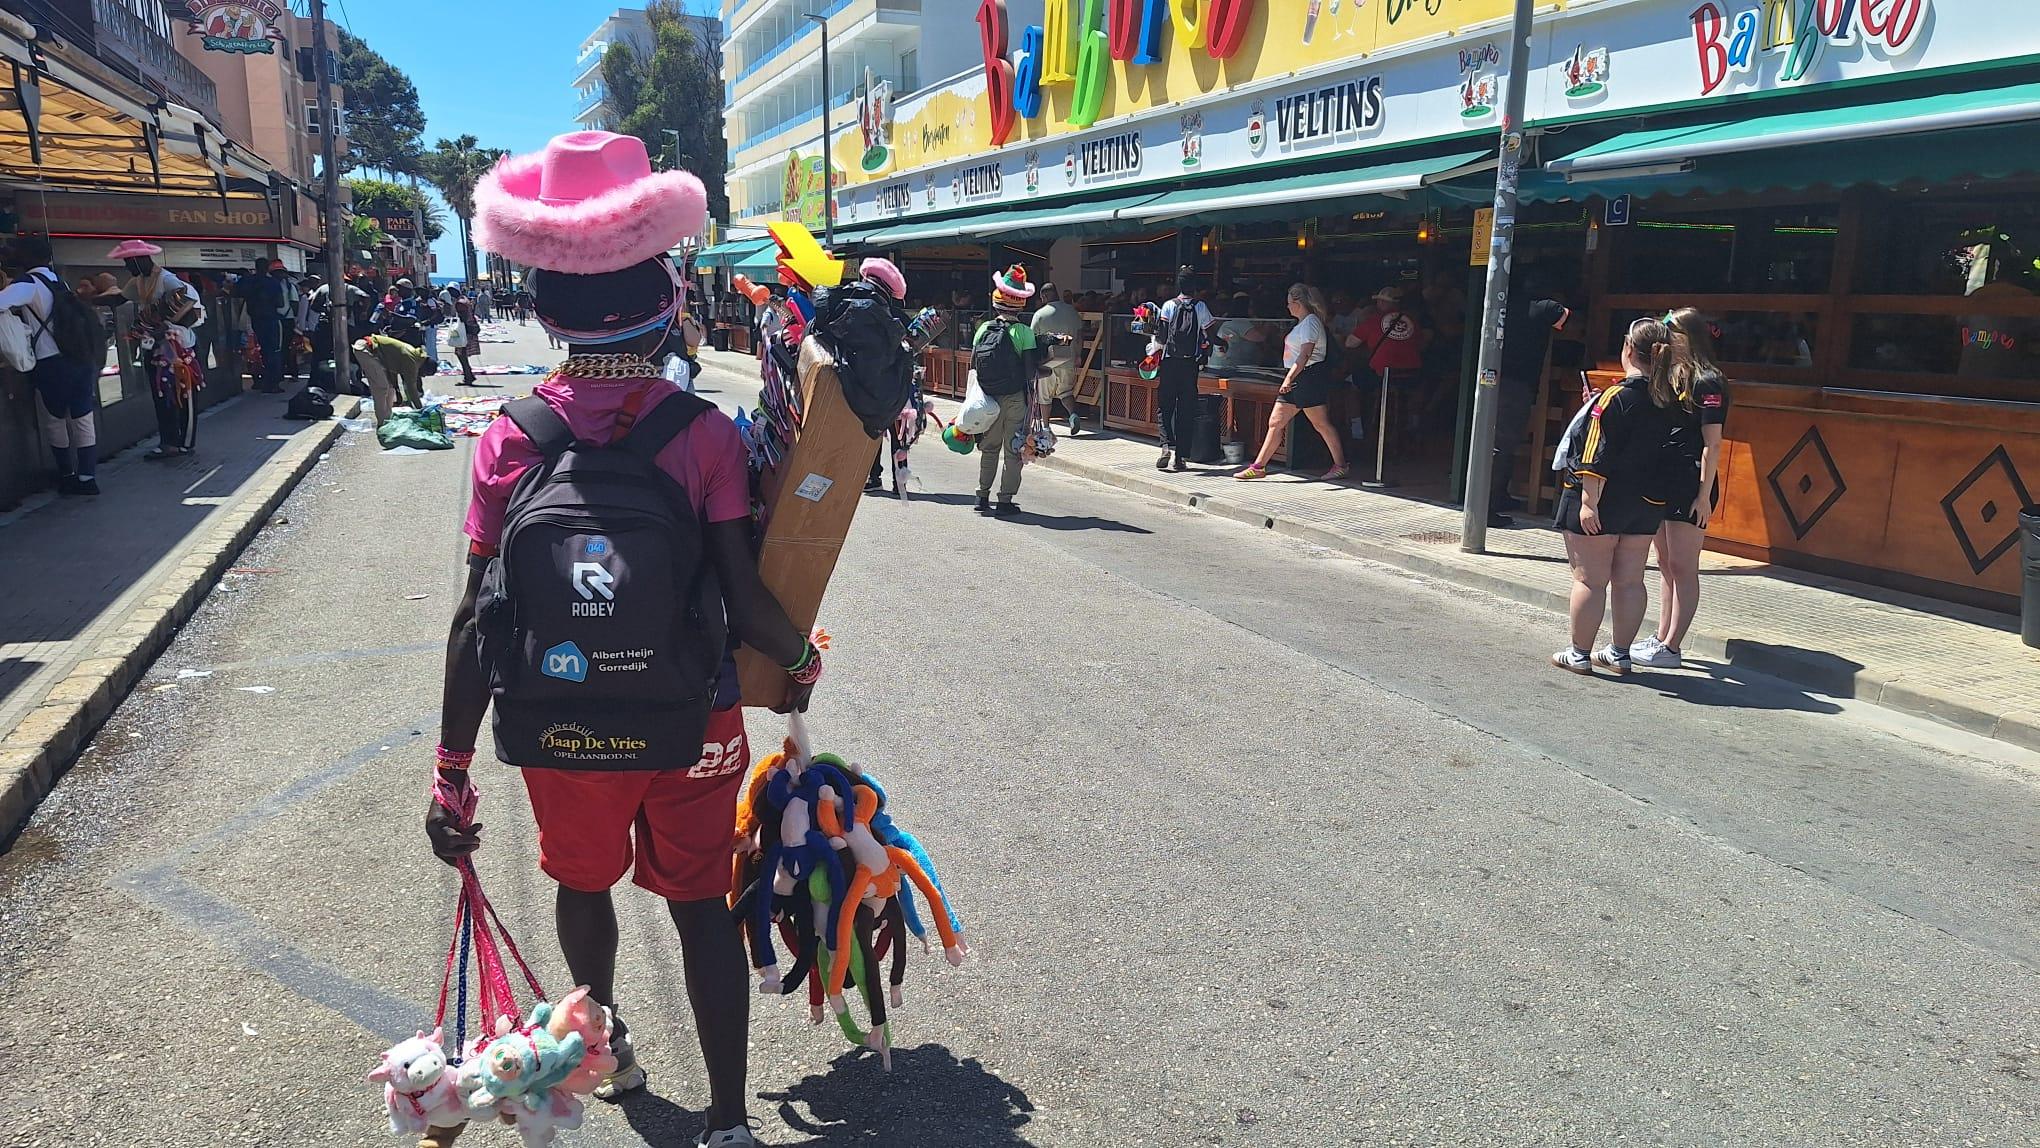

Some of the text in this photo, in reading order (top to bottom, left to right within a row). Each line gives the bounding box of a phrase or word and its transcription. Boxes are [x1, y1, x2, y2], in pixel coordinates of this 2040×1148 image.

[1276, 77, 1380, 143] VELTINS
[1081, 132, 1140, 176] VELTINS
[963, 163, 1001, 197] VELTINS
[883, 183, 910, 209] VELTINS
[1613, 200, 1623, 215] C
[169, 210, 207, 223] FAN
[215, 211, 270, 226] SHOP
[572, 602, 615, 617] ROBEY
[592, 648, 654, 660] Albert Heijn
[598, 661, 649, 672] Gorredijk
[547, 735, 647, 752] Jaap De Vries
[553, 750, 639, 760] OPELAANBOD.NL
[686, 734, 743, 779] 22
